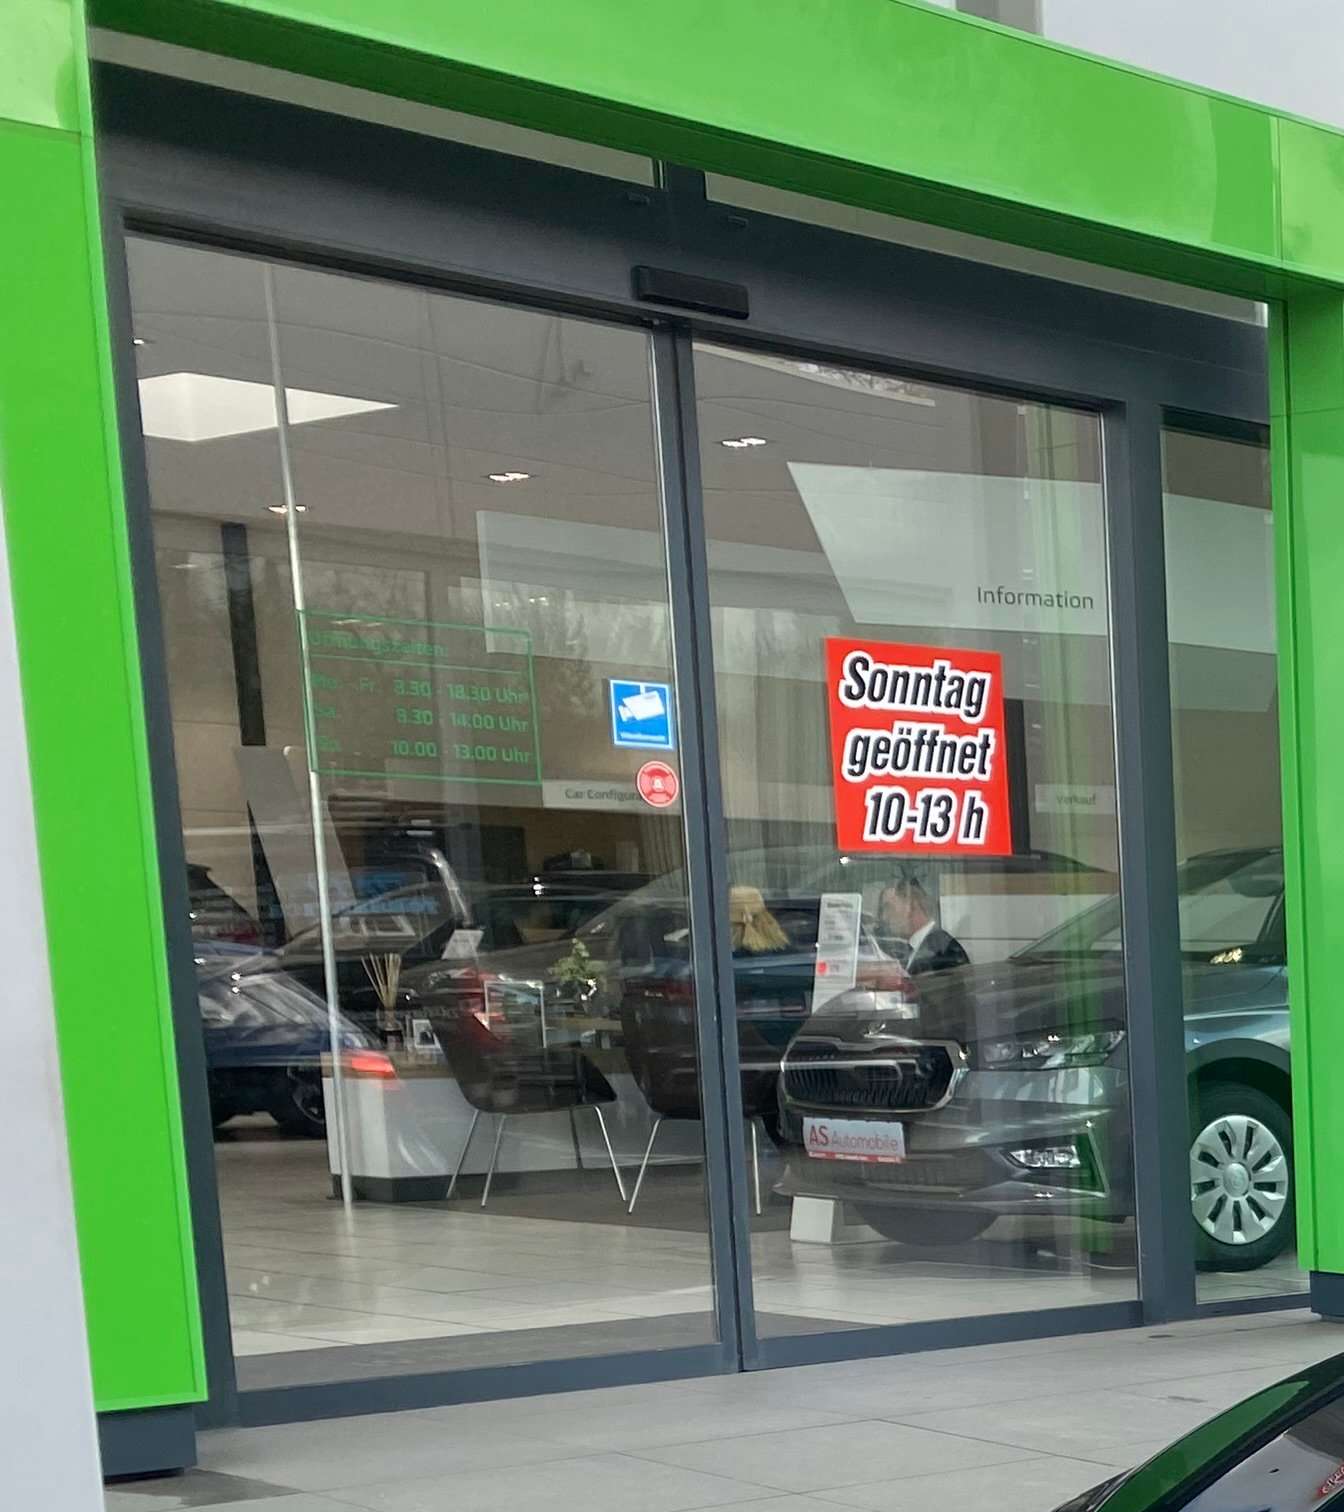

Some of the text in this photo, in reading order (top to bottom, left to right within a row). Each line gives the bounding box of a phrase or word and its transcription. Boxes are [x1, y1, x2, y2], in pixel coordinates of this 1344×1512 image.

[976, 586, 1095, 609] Information
[496, 685, 529, 704] Uhr
[844, 655, 987, 719] Sonntag
[498, 715, 529, 733] Uhr
[502, 746, 531, 764] Uhr
[847, 727, 992, 777] geöffnet
[869, 791, 985, 839] 10-13 h
[808, 1125, 830, 1146] AS
